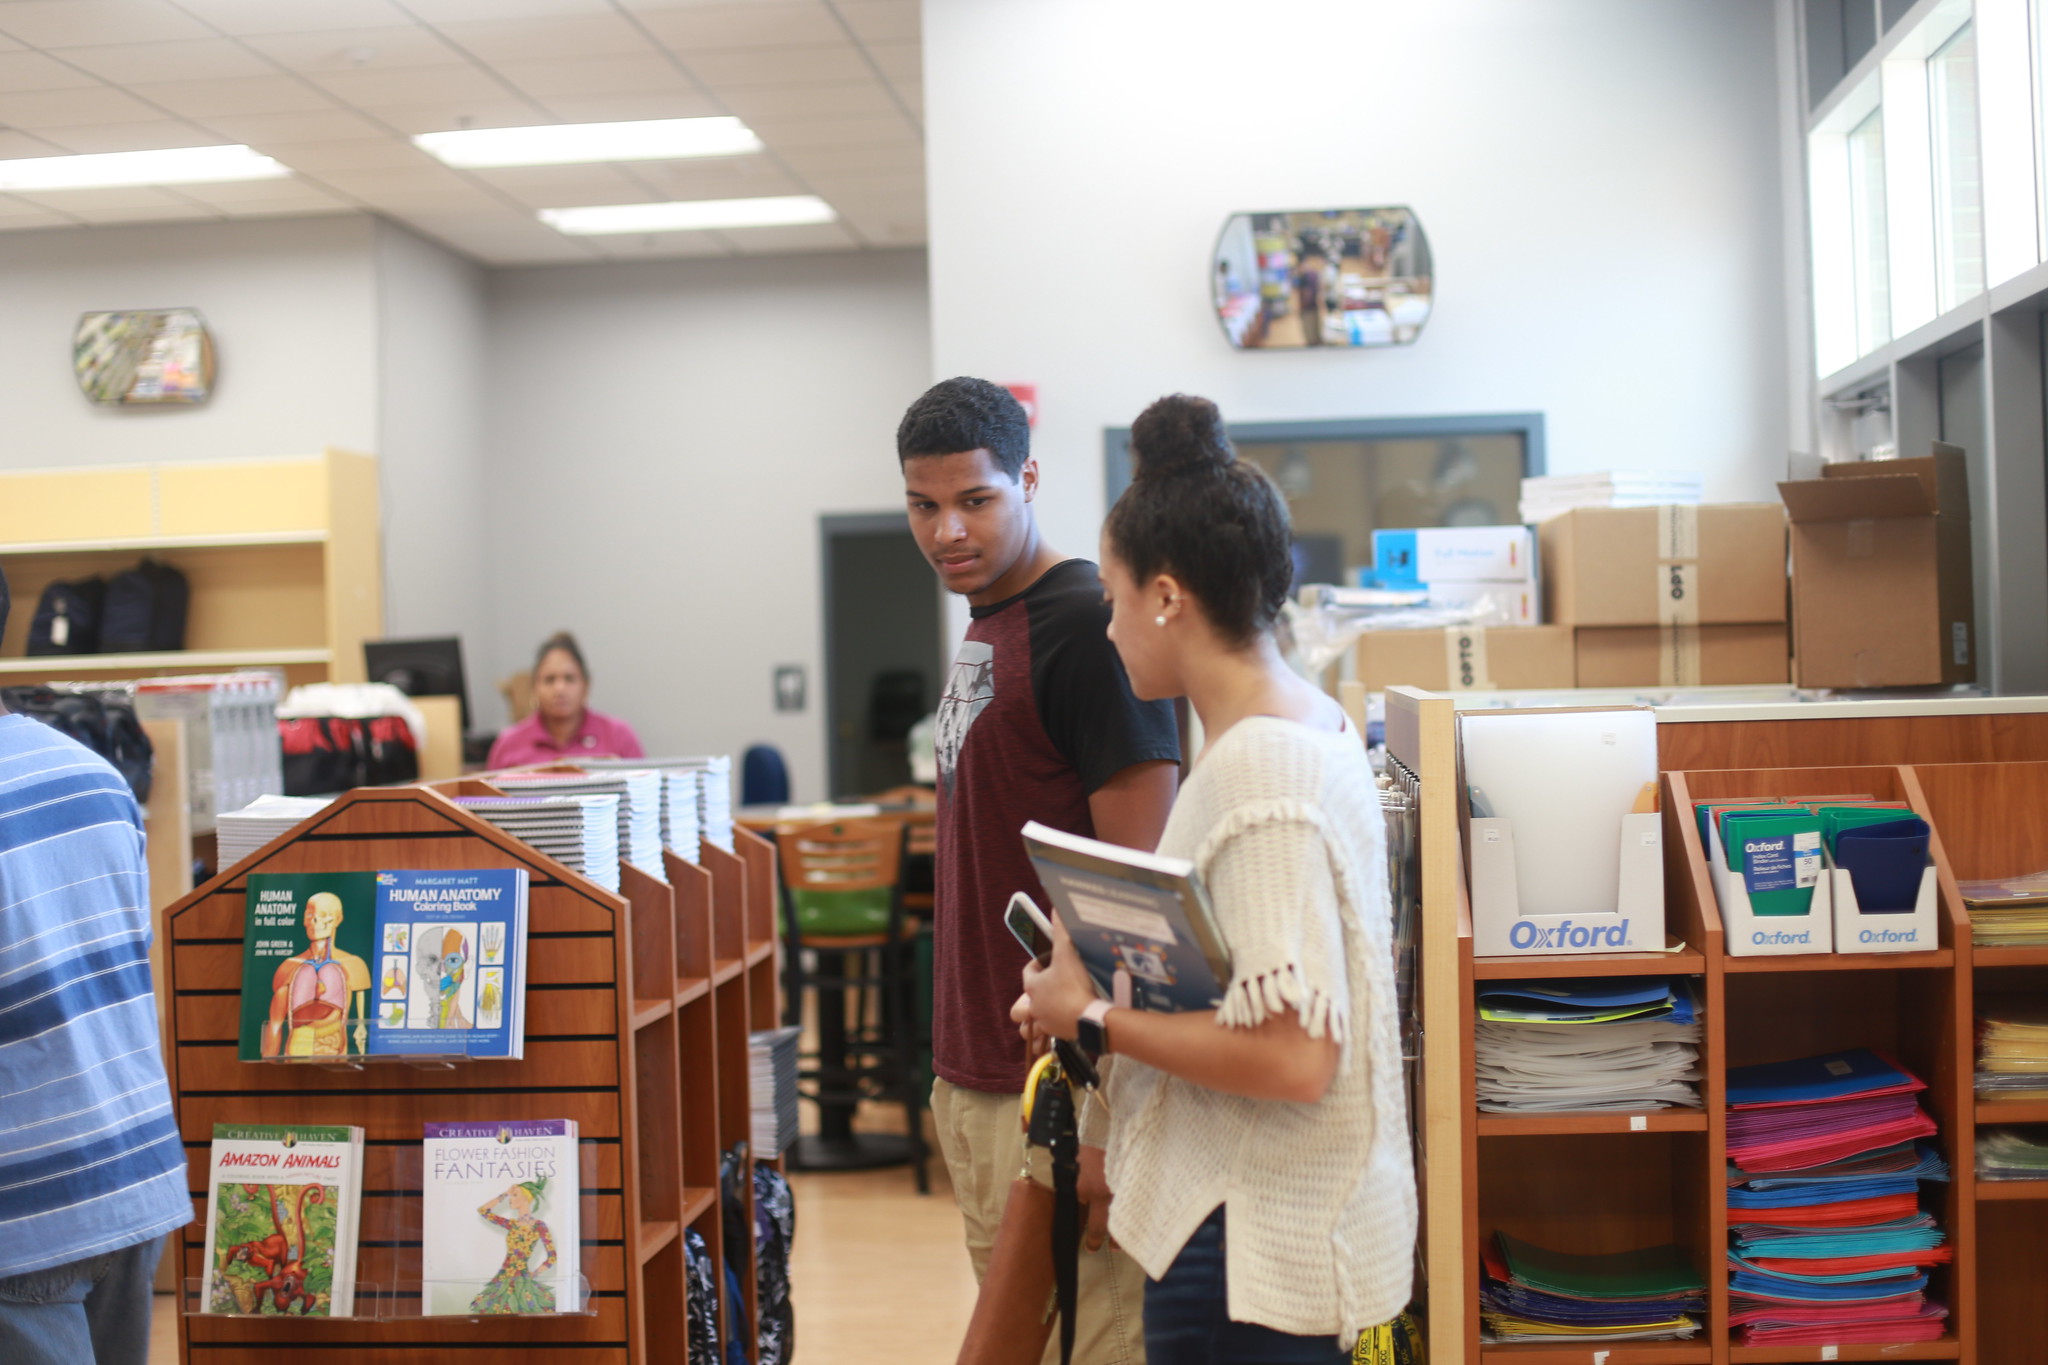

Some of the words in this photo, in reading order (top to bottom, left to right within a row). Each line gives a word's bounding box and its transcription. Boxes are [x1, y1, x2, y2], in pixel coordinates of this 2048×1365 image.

[1458, 636, 1474, 687] OPTO
[1745, 840, 1784, 853] Oxford
[415, 877, 456, 885] MARGARET
[260, 890, 293, 902] HUMAN
[389, 888, 438, 902] HUMAN
[439, 887, 502, 901] ANATOMY
[254, 902, 297, 916] ANATOMY
[413, 901, 452, 914] Coloring
[453, 901, 478, 912] Book
[255, 916, 262, 926] in
[263, 916, 276, 926] full
[277, 916, 296, 927] color
[1509, 918, 1630, 950] Oxford
[1752, 930, 1810, 945] Oxford
[1859, 928, 1917, 943] Oxford
[254, 940, 270, 948] JOHN
[227, 1130, 279, 1140] CREATIVE
[295, 1132, 336, 1141] HAVEN
[439, 1127, 494, 1138] CREATIVE
[514, 1127, 552, 1136] HAVEN
[219, 1152, 280, 1167] AMAZON
[283, 1154, 341, 1168] ANIMALS
[435, 1148, 489, 1161] FLOWER
[493, 1146, 556, 1160] FASHION
[434, 1161, 556, 1179] FANTASIES
[1360, 1338, 1368, 1355] DCC
[1380, 1350, 1388, 1365] DCC
